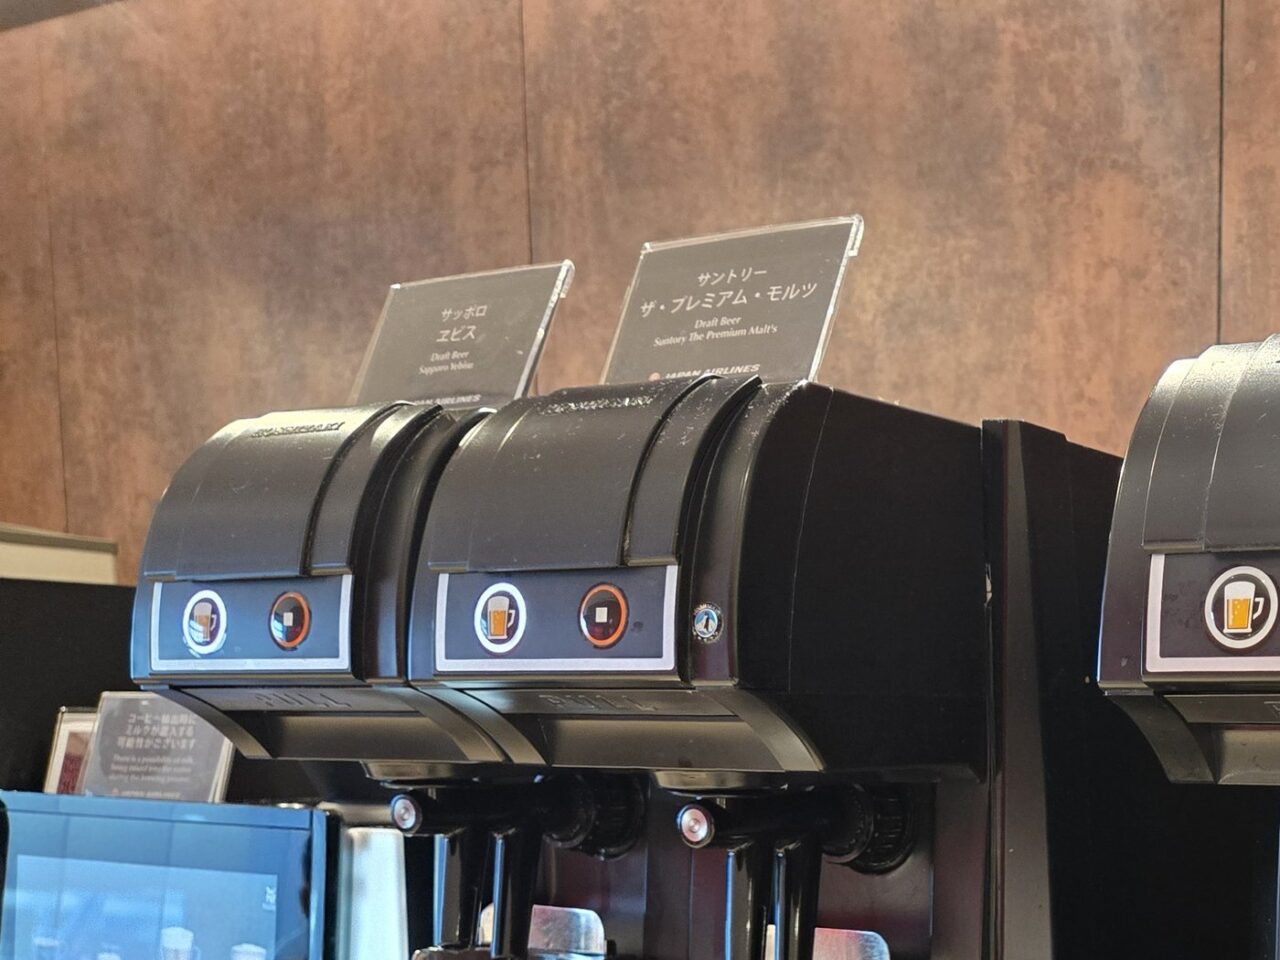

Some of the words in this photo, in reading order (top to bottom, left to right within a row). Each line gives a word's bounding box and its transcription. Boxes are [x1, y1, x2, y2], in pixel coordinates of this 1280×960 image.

[698, 267, 767, 286] サントリー
[640, 283, 818, 318] ザ・プレミアム・モルツ
[441, 304, 488, 322] サッポロ
[694, 317, 718, 329] Draft
[720, 315, 742, 327] Beer
[653, 335, 687, 348] Suntory
[689, 331, 705, 343] The
[706, 327, 747, 340] Premium
[748, 323, 778, 335] Malt's
